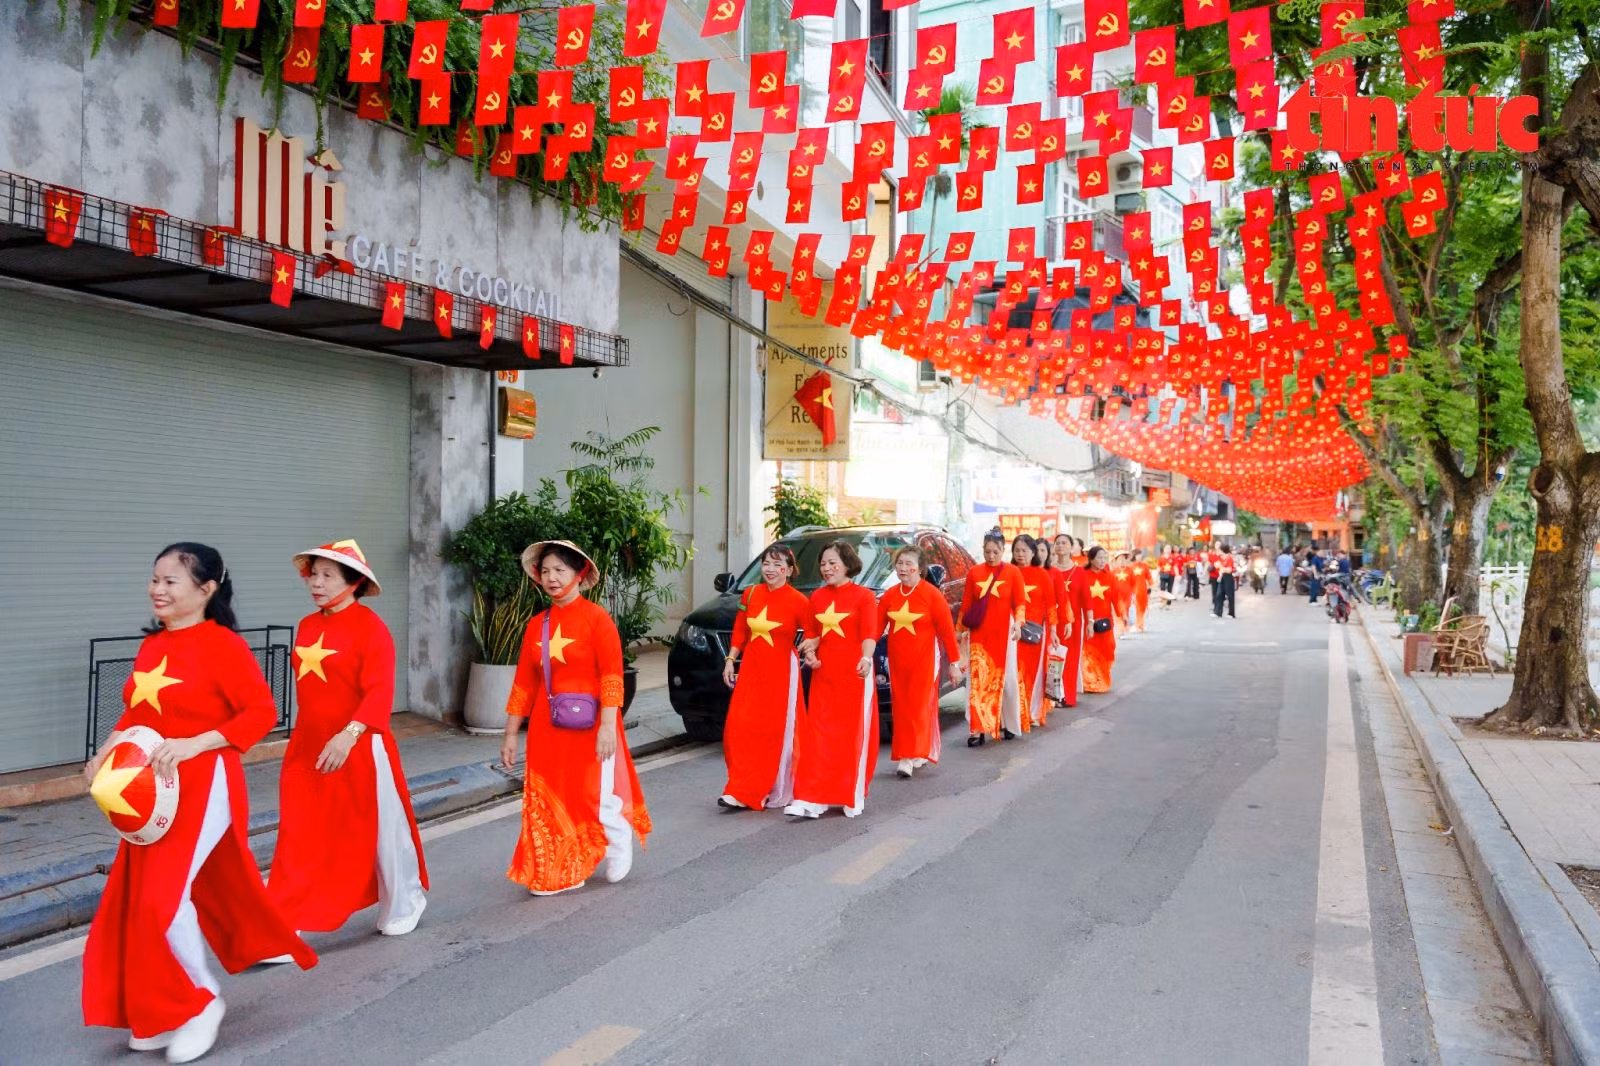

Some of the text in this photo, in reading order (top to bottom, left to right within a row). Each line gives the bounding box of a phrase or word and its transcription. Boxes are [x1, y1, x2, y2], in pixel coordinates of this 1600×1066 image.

[352, 235, 568, 321] CAFÉ & COCKTAIL
[772, 342, 848, 364] Aptments
[156, 815, 169, 829] 5G
